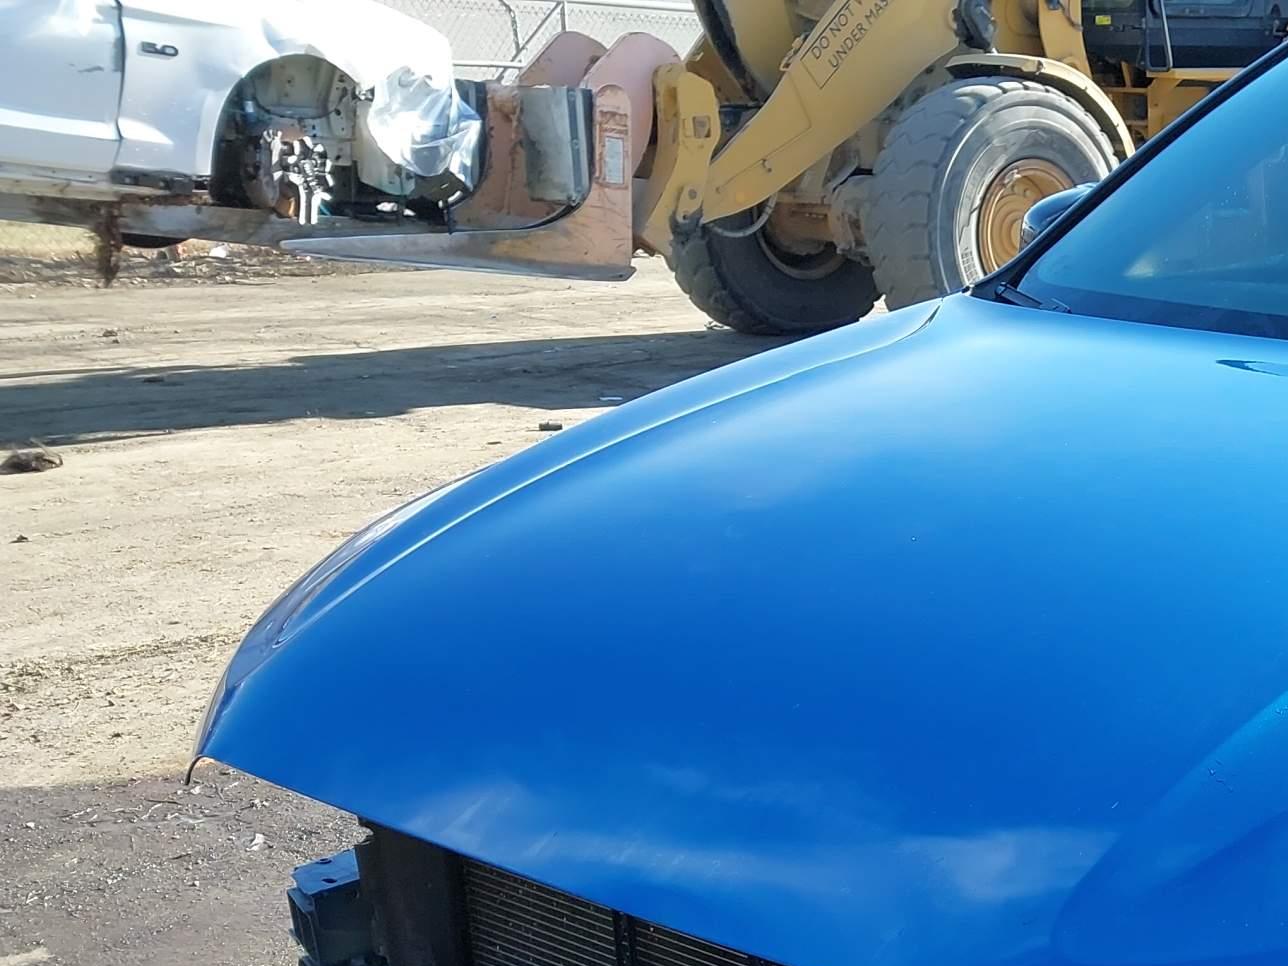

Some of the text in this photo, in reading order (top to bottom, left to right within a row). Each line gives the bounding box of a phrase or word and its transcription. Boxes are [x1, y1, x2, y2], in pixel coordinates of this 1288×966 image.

[811, 3, 854, 60] DO NOT
[828, 22, 867, 68] UNDER
